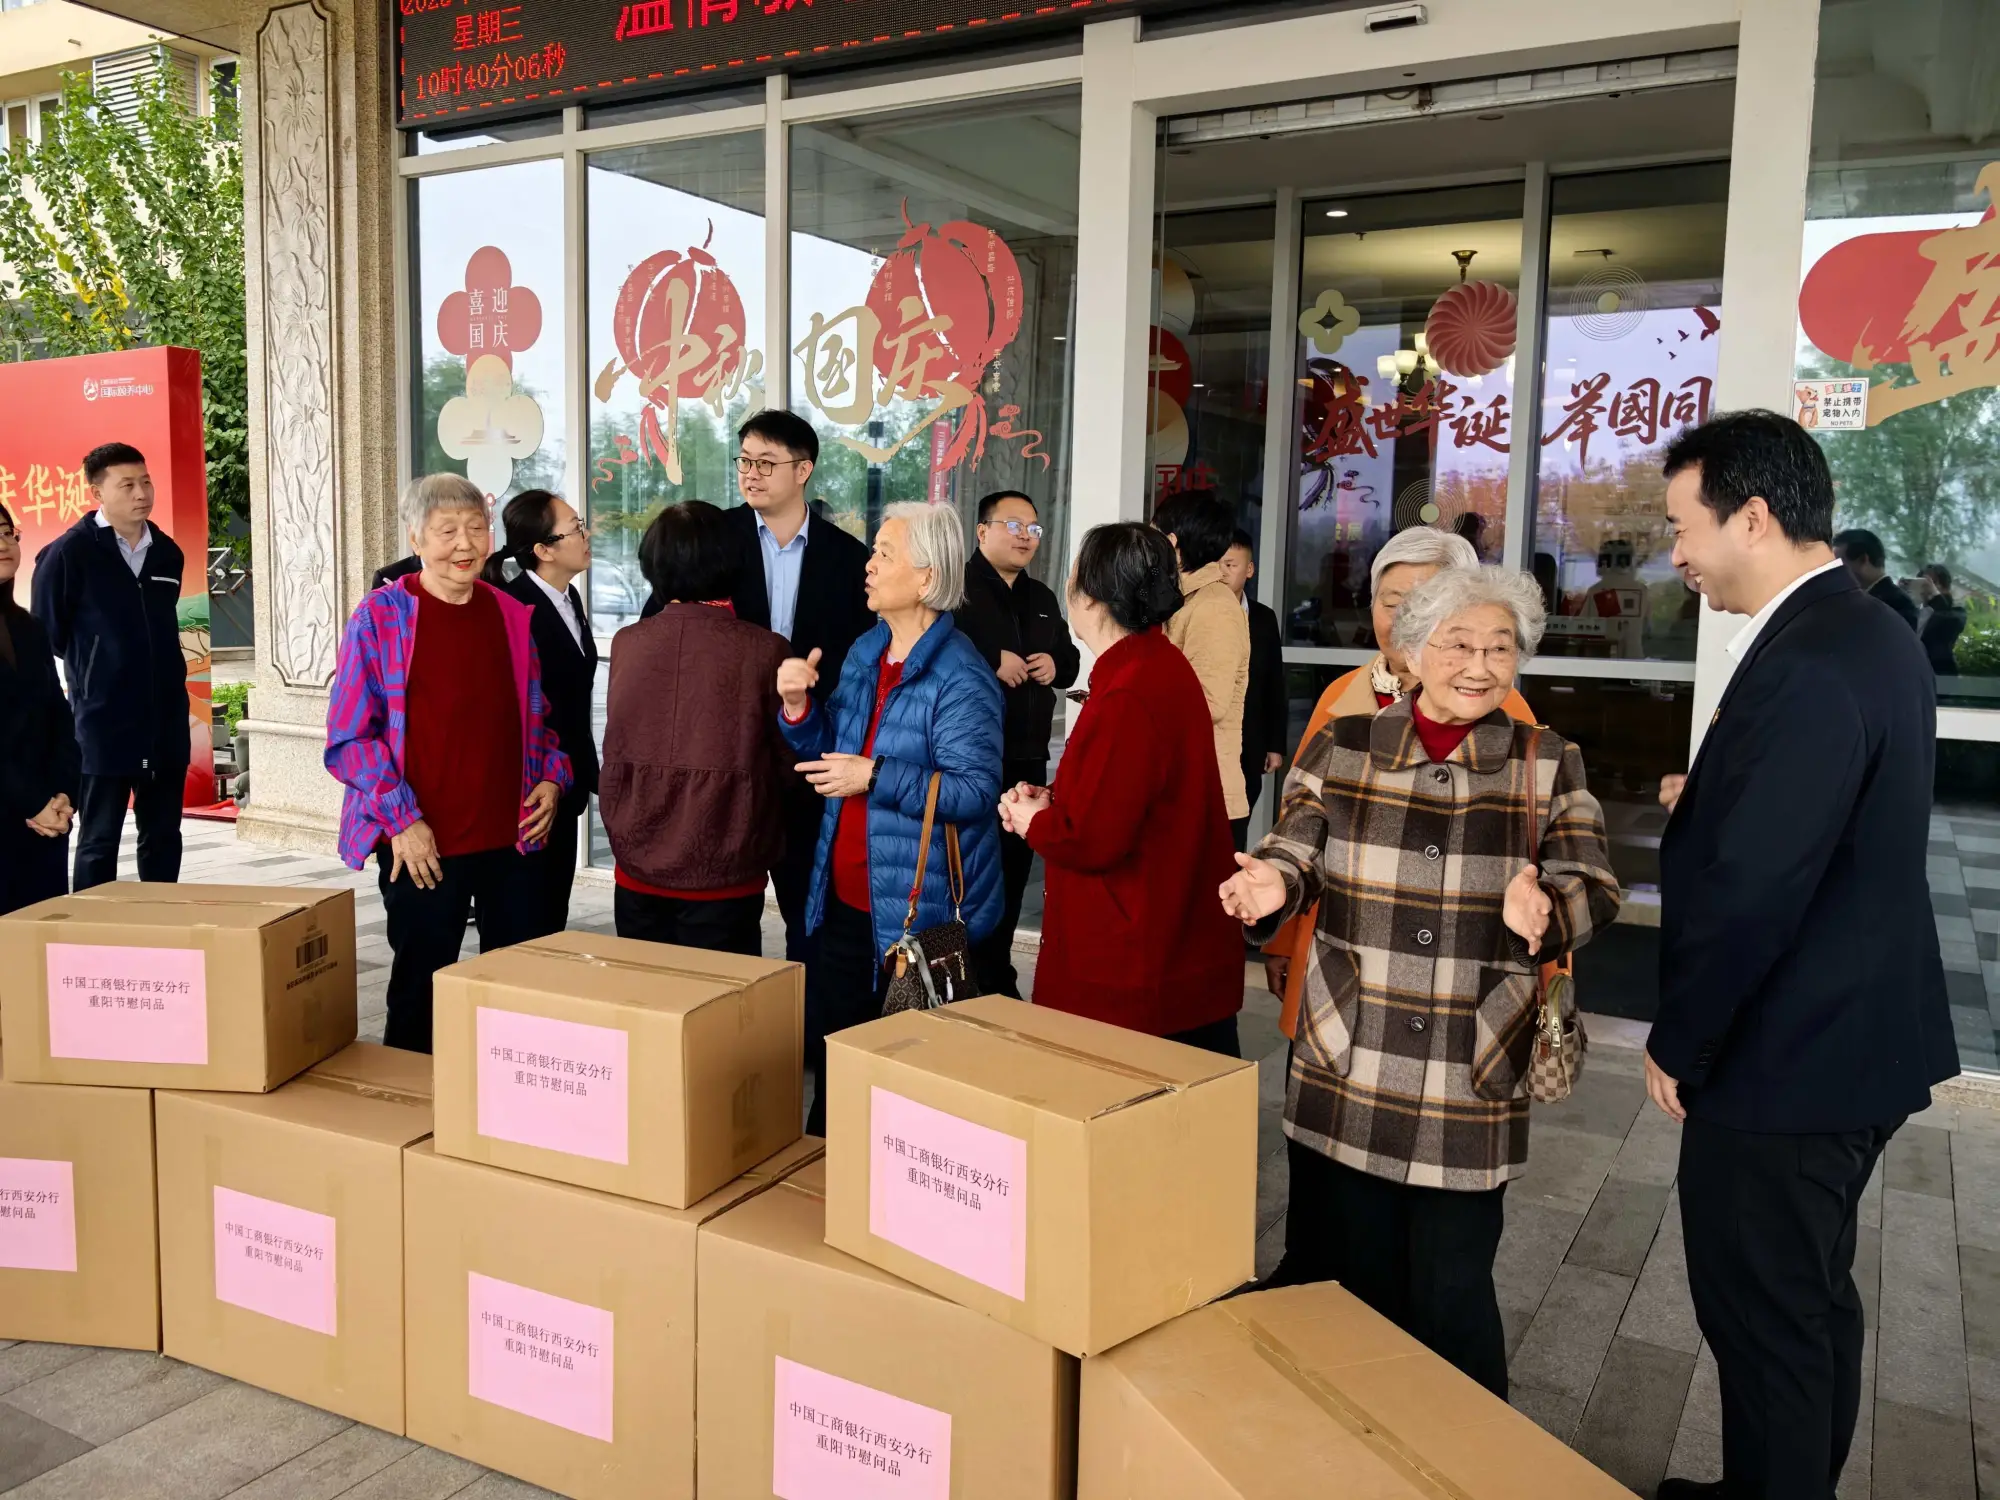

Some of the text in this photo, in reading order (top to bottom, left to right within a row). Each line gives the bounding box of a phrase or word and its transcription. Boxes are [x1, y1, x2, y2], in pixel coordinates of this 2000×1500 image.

[453, 6, 524, 50] 星期三
[416, 41, 566, 99] 10时40分06秒
[469, 320, 509, 349] 国庆
[594, 277, 764, 486] 中秋
[793, 296, 973, 463] 国庆
[1308, 366, 1511, 461] 盛世华诞
[1822, 408, 1861, 418] 宠物入内
[1823, 396, 1862, 407] 禁止携带
[62, 975, 190, 995] 中国工商银行西安分行
[88, 994, 165, 1011] 重阳节慰问品
[490, 1045, 613, 1081] 中国工商银行西安分行
[514, 1070, 587, 1097] 重阳节慰问品
[883, 1133, 1010, 1197] 中国工商银行西安分行
[0, 1188, 60, 1204] 行西安分行
[907, 1166, 982, 1211] 重阳节慰问品
[0, 1205, 36, 1219] 慰问品
[224, 1221, 324, 1261] 中国工商银行西安分行
[244, 1245, 304, 1273] 重阳节慰问品
[481, 1310, 599, 1358] 中国工商银行西安分行
[503, 1337, 574, 1371] 重阳节慰问品
[789, 1400, 933, 1466] 中国工商银行西安分行
[815, 1432, 902, 1477] 重阳节慰问品
